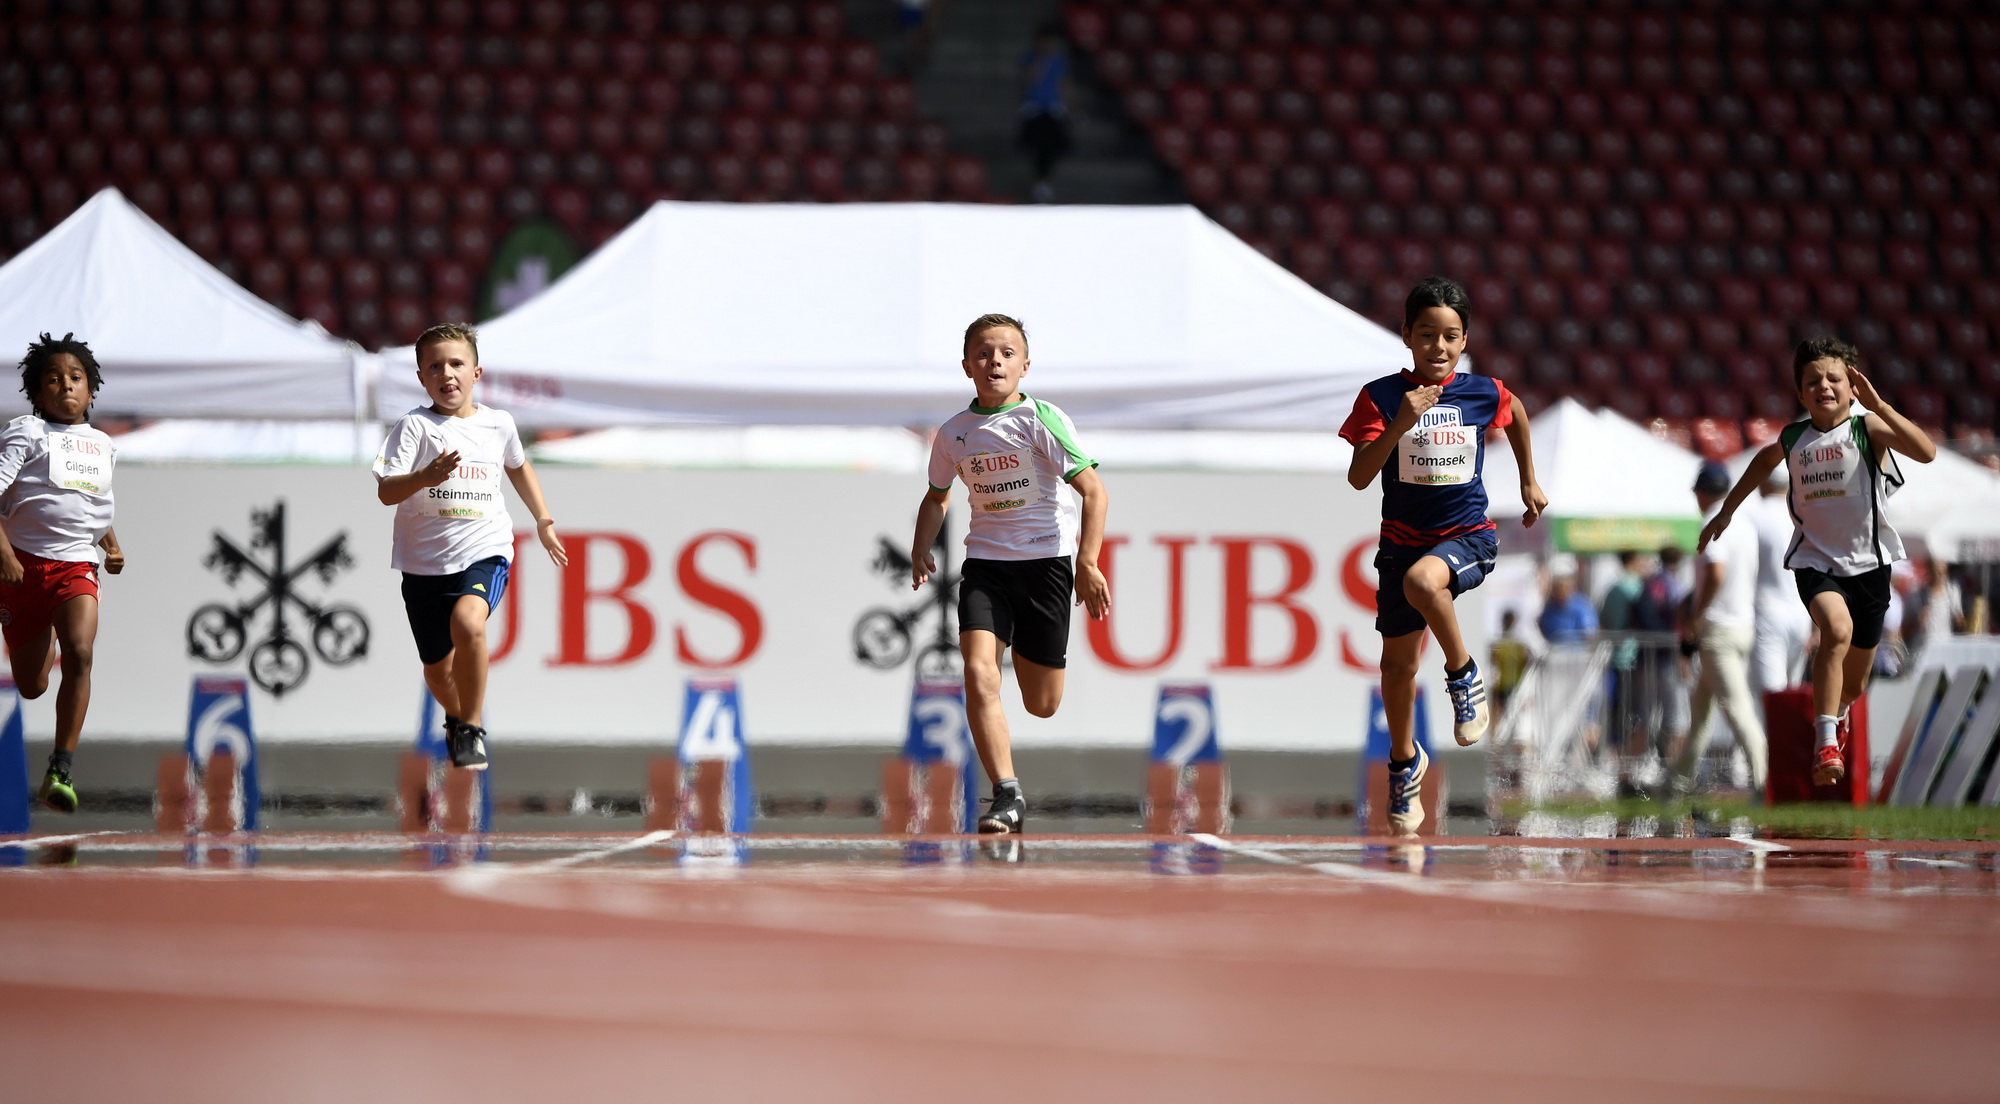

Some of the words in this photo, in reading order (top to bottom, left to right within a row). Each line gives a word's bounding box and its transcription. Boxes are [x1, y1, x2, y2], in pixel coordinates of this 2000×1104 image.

[1433, 430, 1466, 446] UBS
[76, 439, 101, 457] UBS
[1815, 446, 1844, 462] UBS
[65, 460, 99, 476] Gilgien
[984, 453, 1020, 472] UBS
[1409, 454, 1466, 467] Tomasek
[459, 465, 488, 480] UBS
[1801, 470, 1846, 486] Melcher
[973, 477, 1030, 494] Chavanne
[428, 487, 492, 502] Steinmann
[193, 694, 251, 768] 6
[680, 690, 742, 762] 4
[914, 698, 968, 766] 3
[1159, 698, 1211, 766] 2
